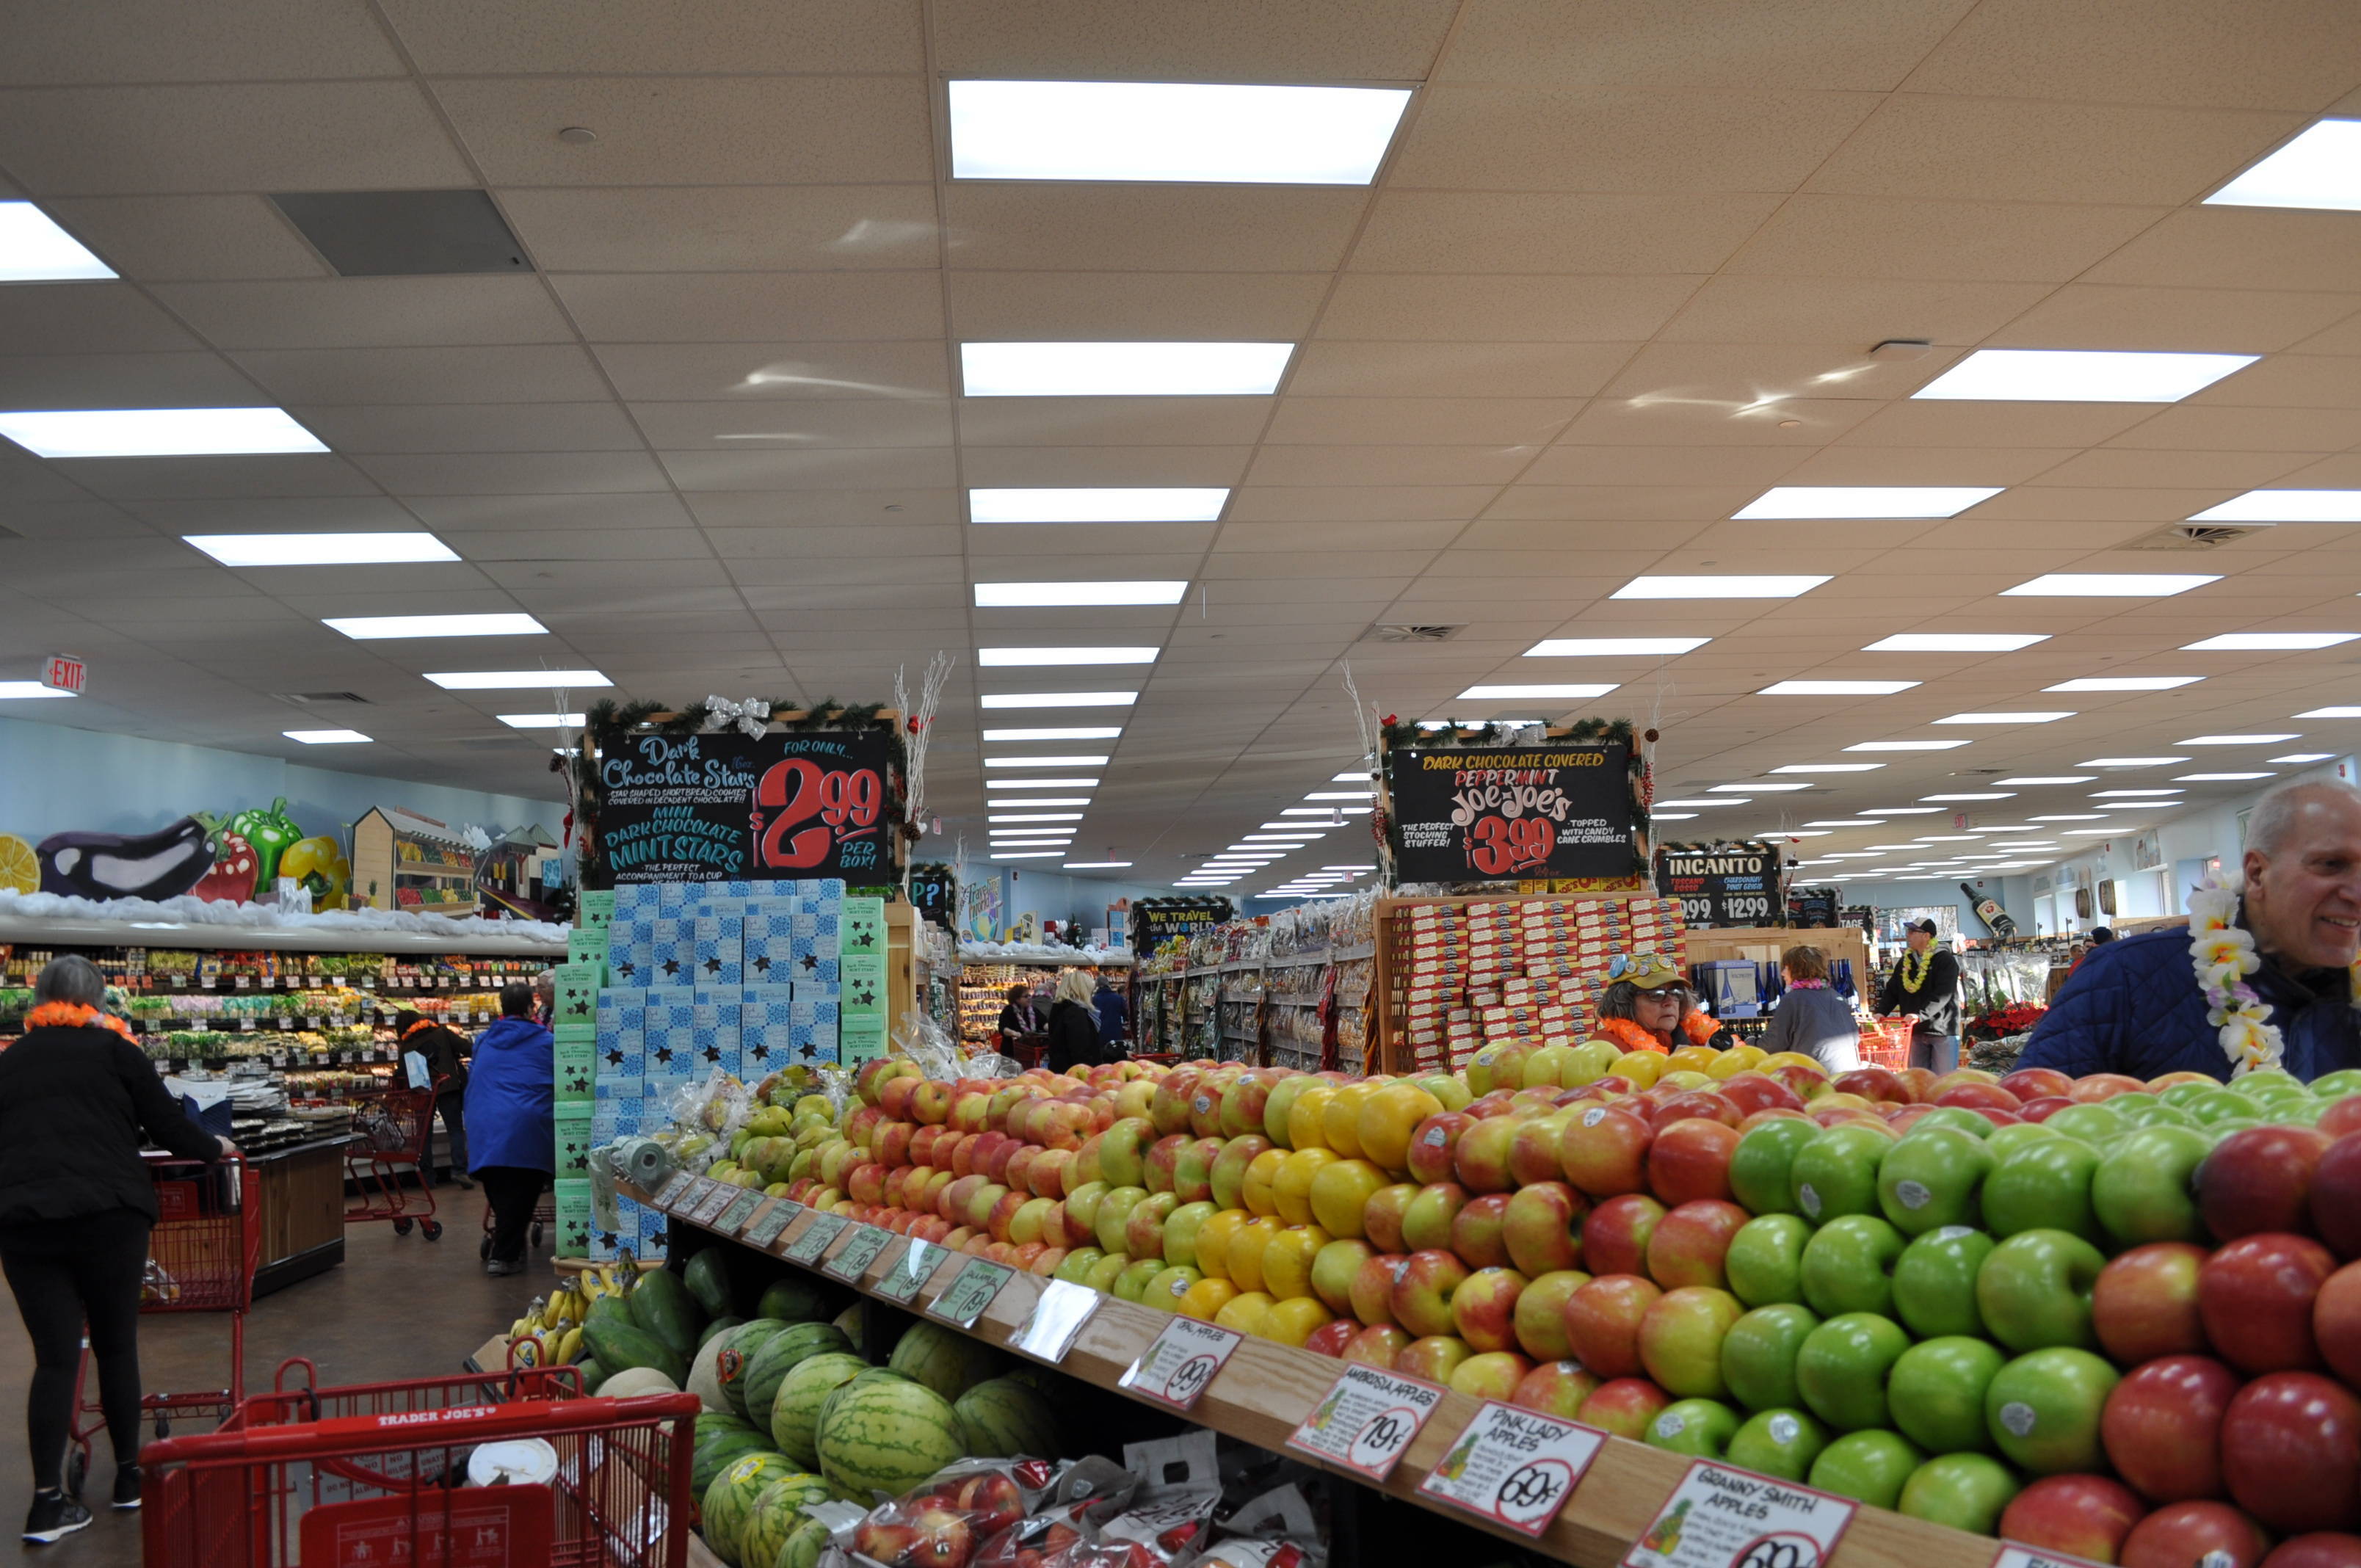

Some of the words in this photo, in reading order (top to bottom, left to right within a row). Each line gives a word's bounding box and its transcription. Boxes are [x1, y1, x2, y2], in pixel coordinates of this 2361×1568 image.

[53, 659, 82, 689] EXIT
[639, 735, 700, 766] Dark
[784, 740, 810, 755] FOR
[1423, 755, 1463, 771] DARK
[1465, 754, 1542, 769] CHOCOLATE
[1544, 752, 1606, 767] COVERED
[603, 758, 700, 788] Chocolate
[704, 758, 755, 788] Stars
[1455, 769, 1559, 787] PEPPERMINT
[608, 796, 645, 805] COVERED
[645, 796, 653, 805] IN
[653, 796, 692, 805] DECADENT
[629, 788, 660, 798] SHAPED
[662, 788, 712, 797] SHORTBREAD
[713, 788, 747, 797] COOKIES
[653, 806, 694, 819] MINI
[1451, 785, 1573, 827] Joe-Joe's
[605, 821, 651, 848] DARK
[652, 819, 742, 843] CHOCOLATE
[1404, 831, 1448, 840] STOCKING
[1419, 822, 1456, 832] PERFECT
[1562, 828, 1583, 836] WITH
[1585, 827, 1614, 835] CANDY
[842, 841, 876, 854] PER
[1404, 838, 1451, 849] STUFFER!
[1556, 836, 1581, 845] CANE
[1583, 834, 1627, 844] CRUMBLES
[609, 834, 674, 871] MINT
[672, 835, 744, 873] STARS
[840, 854, 877, 870] BOX!
[662, 863, 700, 872] PERFECT
[1669, 857, 1763, 876] INCANTO
[615, 872, 685, 881] ACCOMPANIMENT
[688, 872, 698, 881] TO
[698, 872, 706, 880] A
[706, 871, 722, 880] CUP
[1147, 911, 1167, 922] WE
[1170, 910, 1214, 921] TRAVEL
[1722, 897, 1769, 918] $12.99
[1192, 1326, 1226, 1342] APPLES
[1346, 1368, 1393, 1390] AMBROSIA
[1390, 1383, 1437, 1407] APPLES
[378, 1412, 438, 1426] TRADER
[443, 1407, 485, 1420] JOE'S
[1490, 1409, 1527, 1432] PINK
[1526, 1418, 1573, 1442] LADY
[1484, 1427, 1539, 1453] APPLES
[1697, 1467, 1763, 1497] GRANNY
[1763, 1487, 1818, 1515] SMITH
[1705, 1492, 1770, 1520] APPLES
